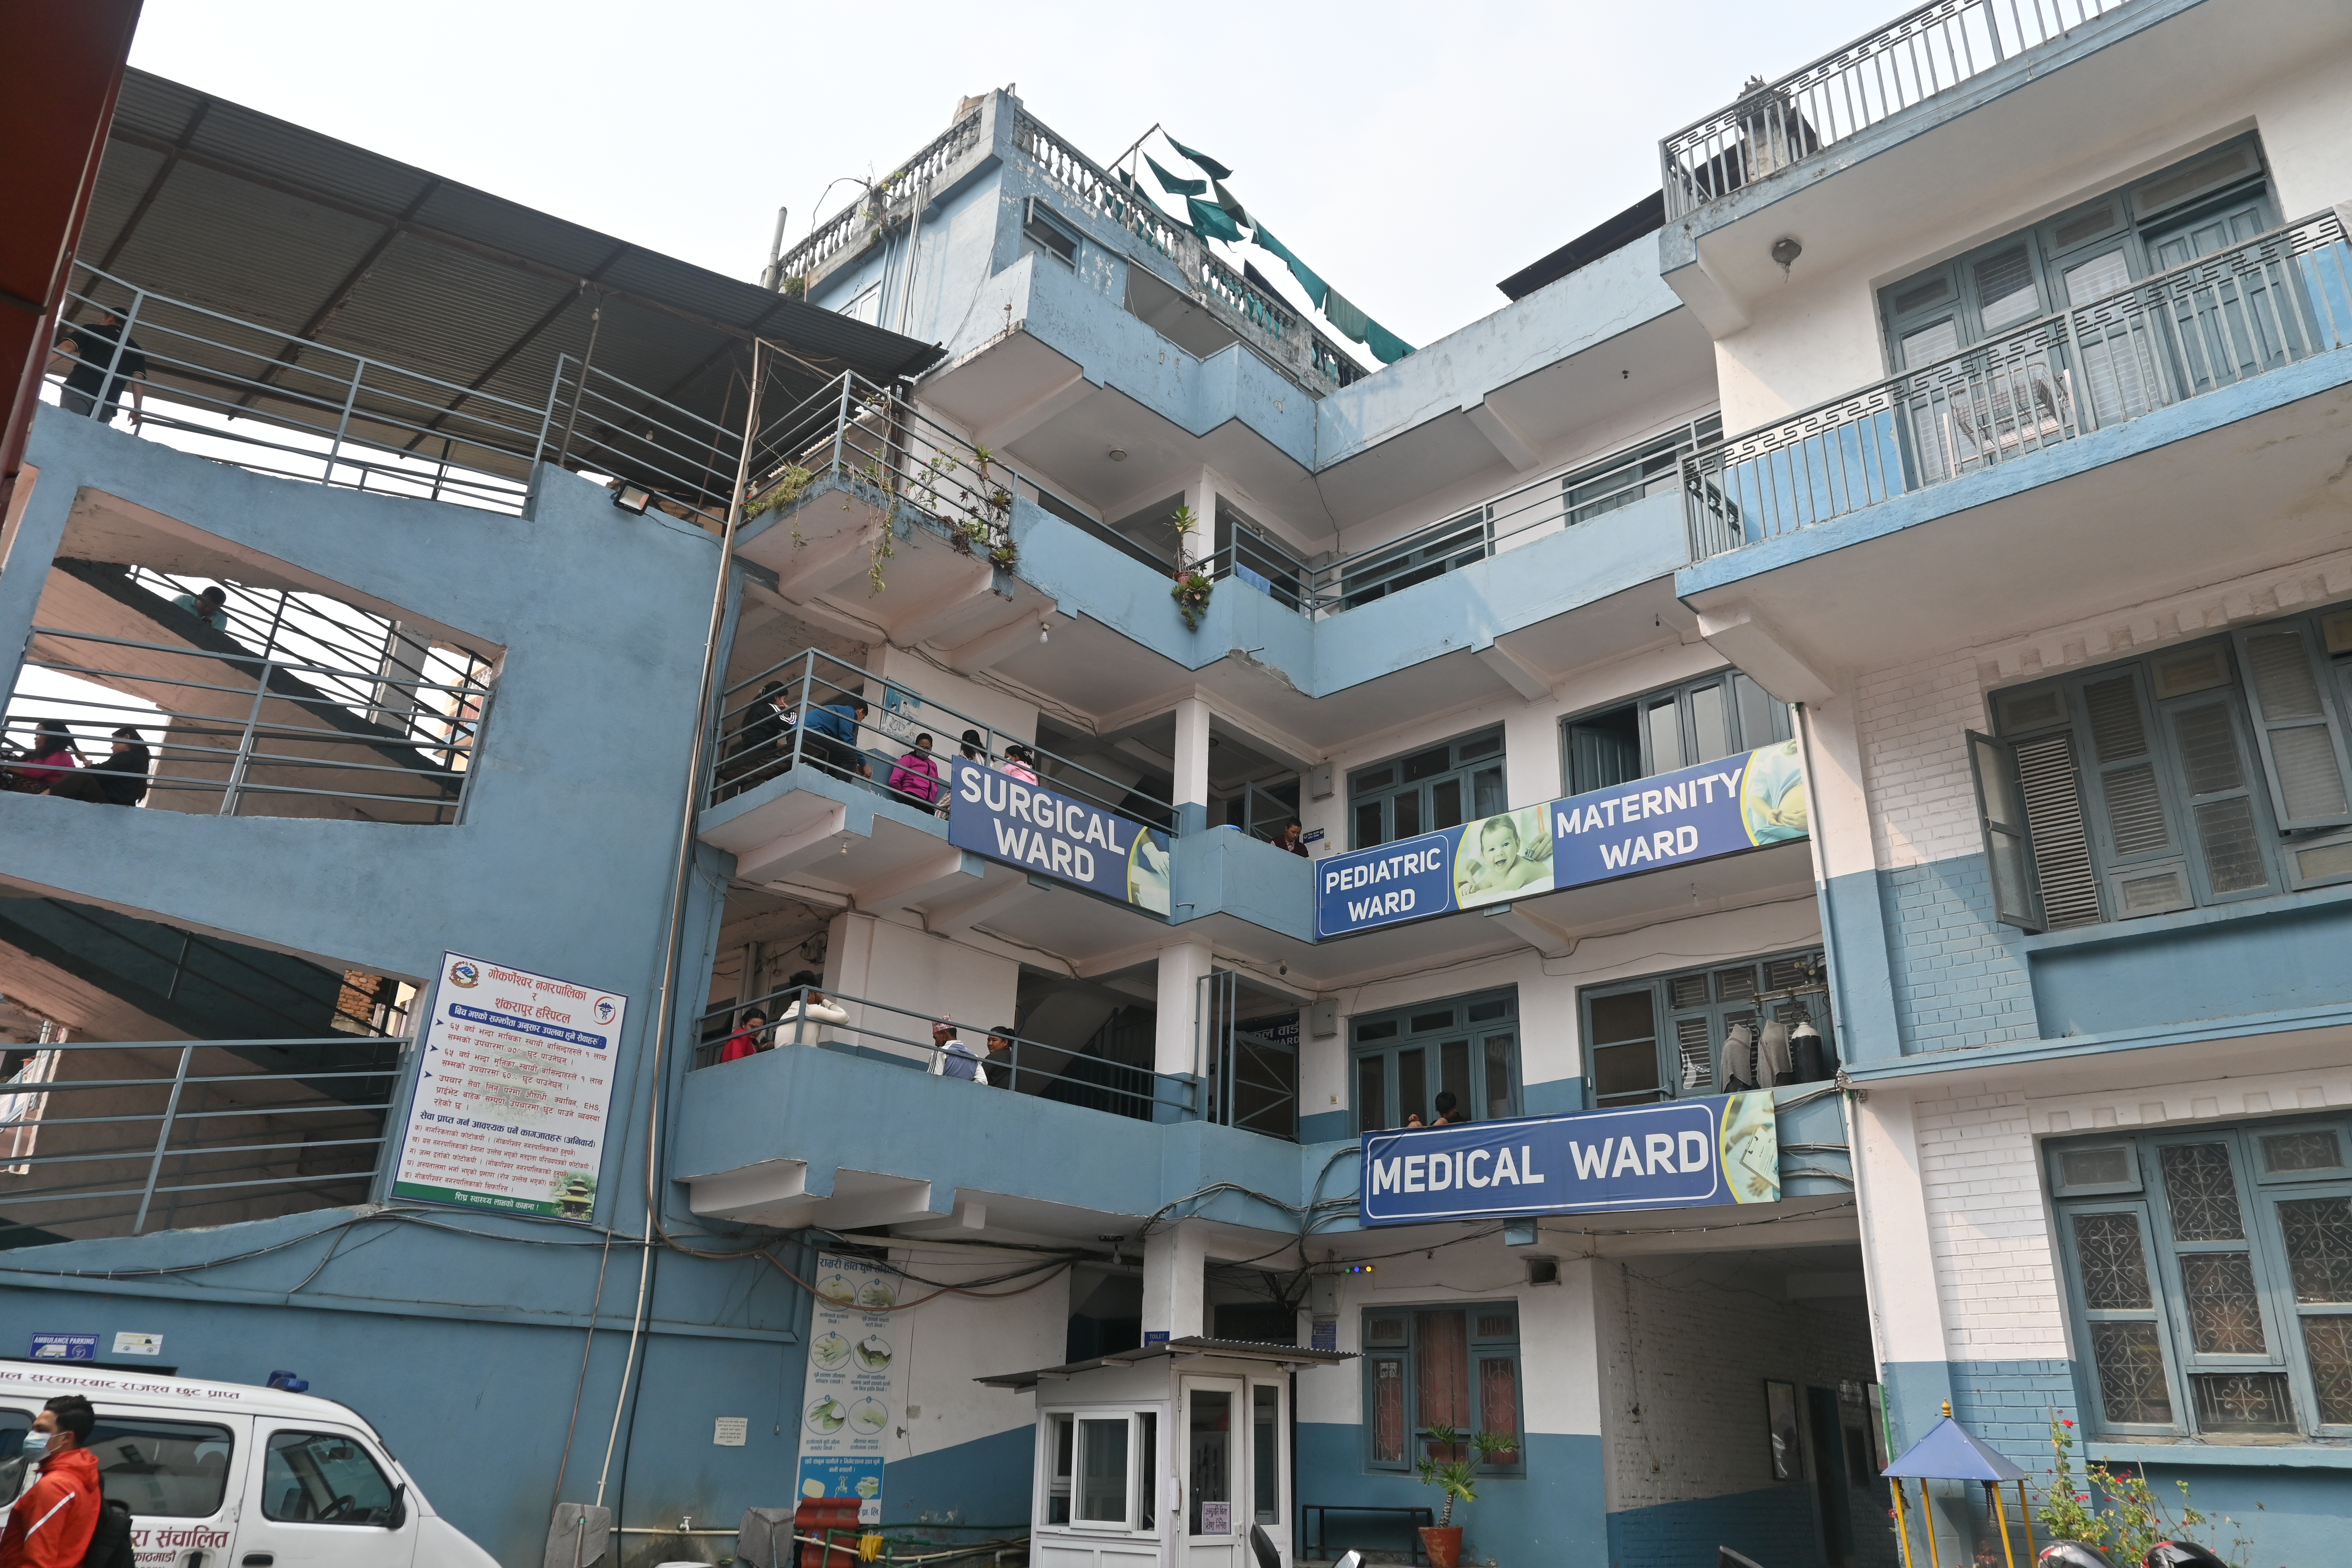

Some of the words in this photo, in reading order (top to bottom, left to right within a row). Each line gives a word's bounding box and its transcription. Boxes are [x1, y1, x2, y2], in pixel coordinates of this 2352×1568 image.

[960, 767, 1124, 856] SURGICAL
[1557, 768, 1742, 838] MATERNITY
[993, 817, 1094, 882] WARD
[1599, 825, 1698, 869] WARD
[1326, 848, 1441, 894] PEDIATRIC
[1348, 888, 1415, 922] WARD
[487, 966, 534, 988] गोकर्णेश्वर
[535, 980, 587, 1001] नगरपालिका
[531, 992, 538, 1001] र
[468, 1010, 488, 1021] भएको
[488, 1015, 516, 1027] सम्झौता
[517, 1021, 541, 1033] अनुसार
[542, 1026, 564, 1037] उपलब्ध
[564, 1031, 576, 1041] हुने
[494, 997, 534, 1016] शंकरापुर
[535, 1005, 572, 1024] हस्पिटल
[583, 1102, 600, 1112] EHS,
[419, 1110, 436, 1121] सेवा
[437, 1114, 455, 1124] प्राप्त
[456, 1118, 470, 1127] गर्न
[471, 1120, 505, 1132] आवश्यक
[506, 1125, 519, 1135] पर्ने
[564, 1135, 596, 1148] (अनिवार्य)
[1373, 1145, 1544, 1195] MEDICAL
[1569, 1130, 1710, 1180] WARD
[470, 1195, 493, 1204] स्वास्थ्य
[493, 1198, 514, 1207] लाभको
[515, 1201, 535, 1210] कामना
[844, 1261, 857, 1271] हात
[33, 1336, 69, 1344] AMBULANCE
[29, 1374, 117, 1389] सरकारबाट
[176, 1388, 202, 1397] छुट
[207, 1390, 241, 1400] प्राप्त
[871, 1507, 879, 1516] लि.
[155, 1525, 230, 1549] संचालित
